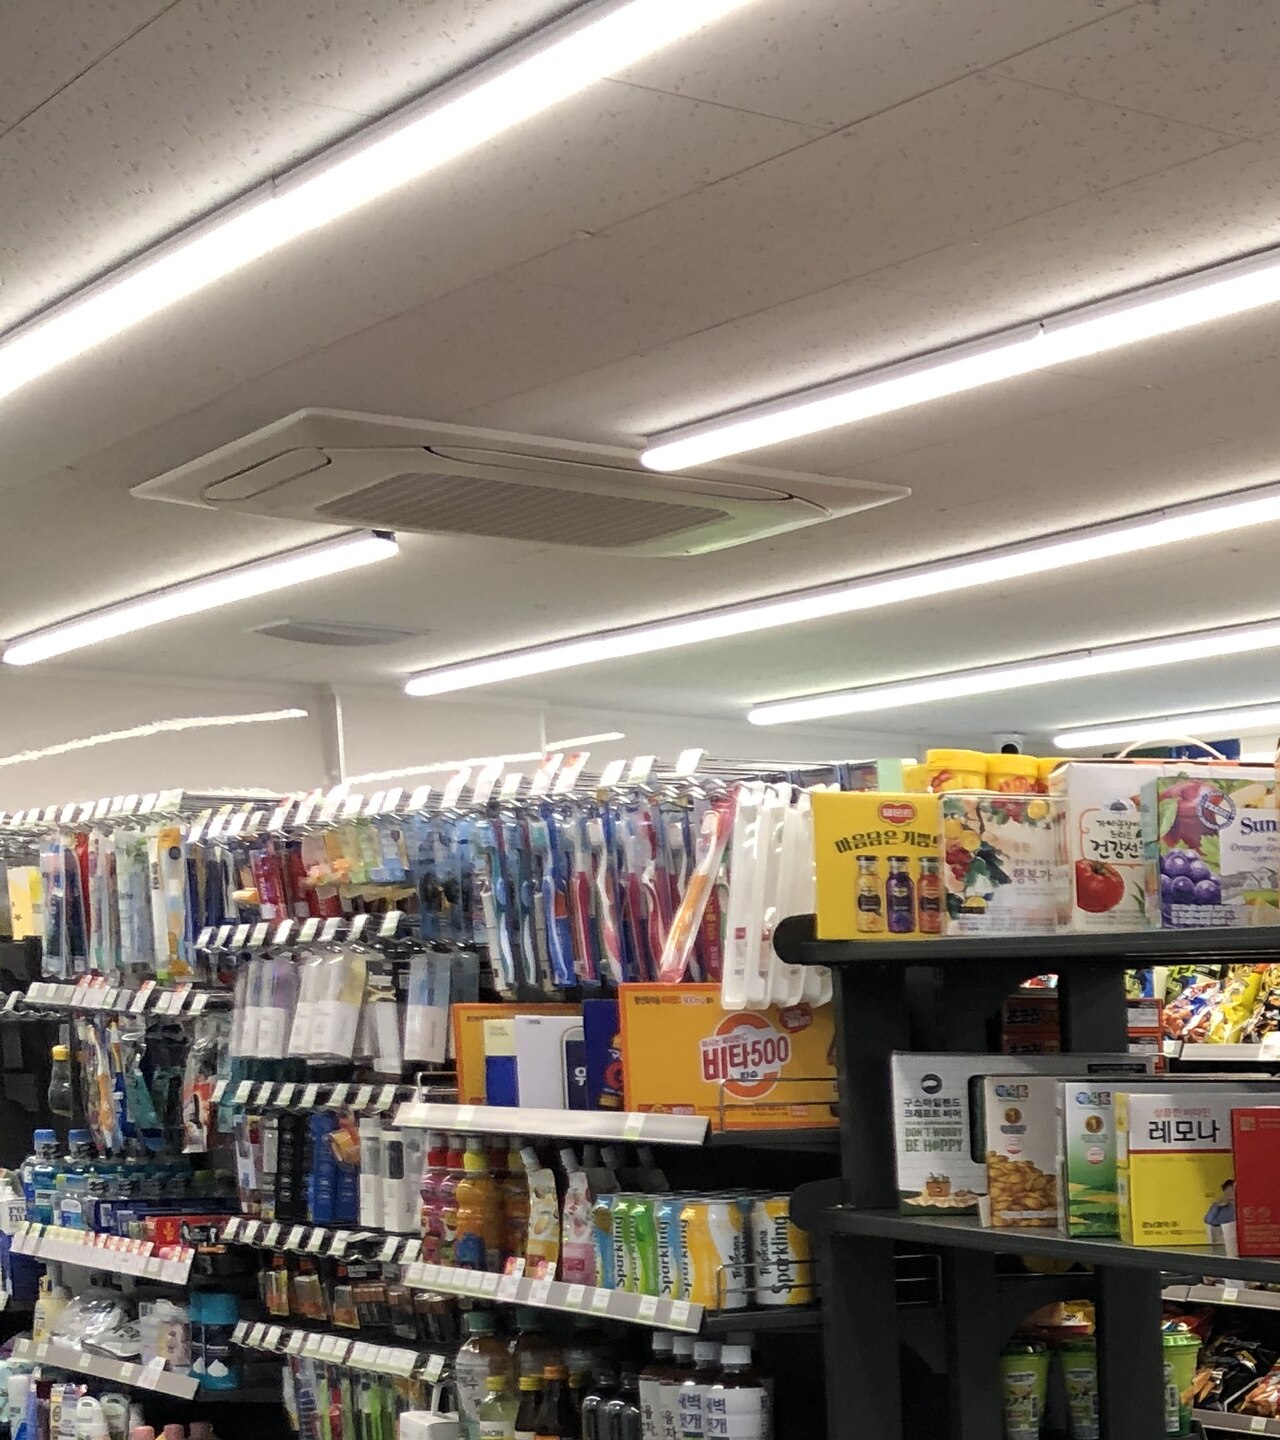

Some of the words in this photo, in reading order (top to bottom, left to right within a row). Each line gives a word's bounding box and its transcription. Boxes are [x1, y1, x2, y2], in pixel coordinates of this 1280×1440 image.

[834, 830, 899, 854] 마음담은
[702, 1035, 789, 1081] 비타500
[905, 1139, 920, 1152] BE
[923, 1138, 963, 1152] HPPY
[1148, 1119, 1220, 1143] 레모나
[616, 1216, 626, 1288] Sparkling
[659, 1220, 673, 1296] Sparkling
[772, 1216, 796, 1295] Sparkling
